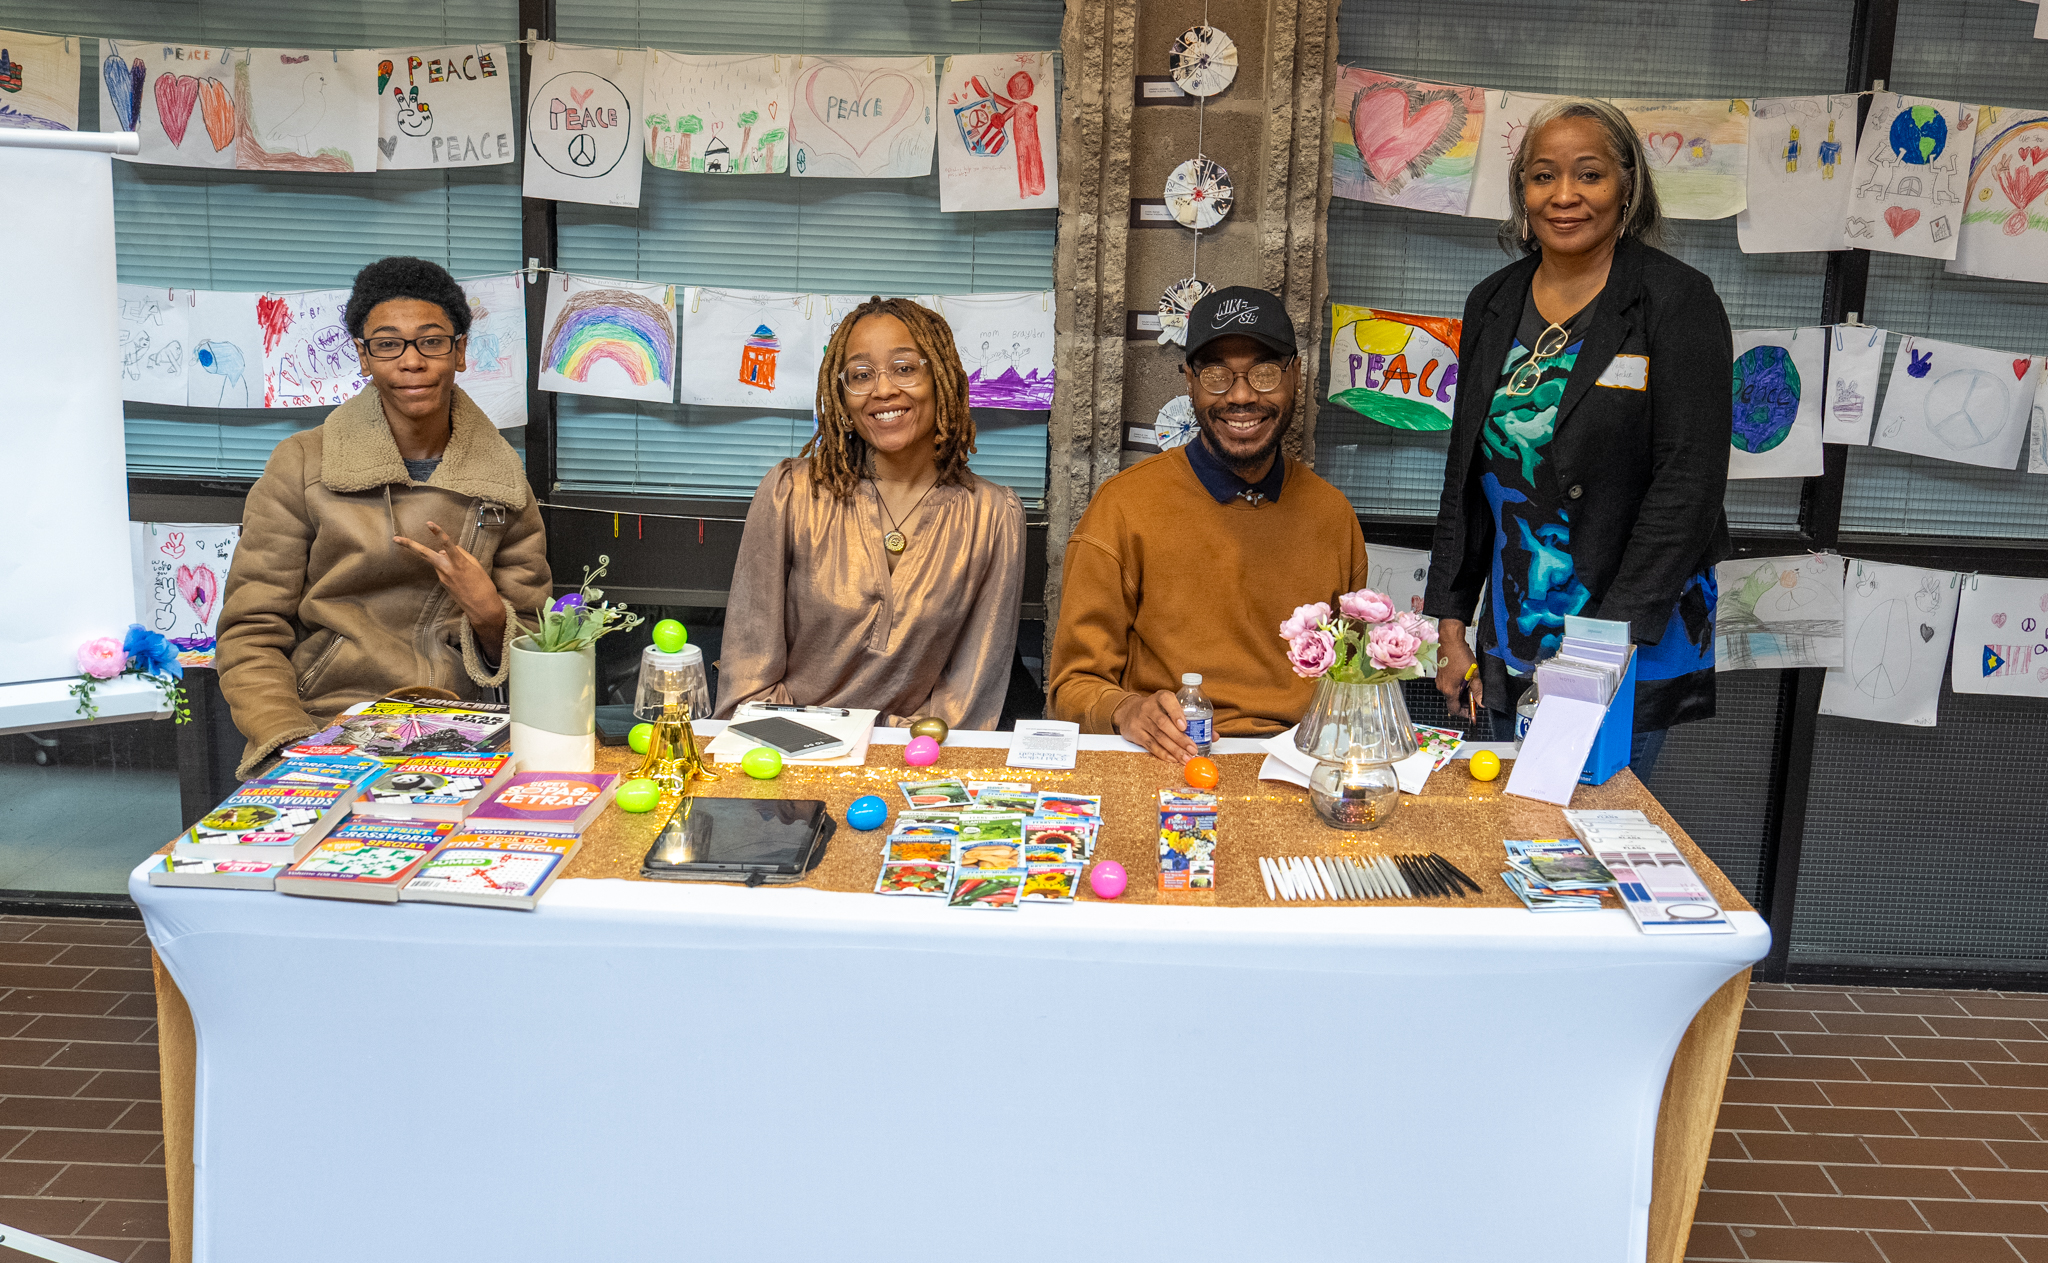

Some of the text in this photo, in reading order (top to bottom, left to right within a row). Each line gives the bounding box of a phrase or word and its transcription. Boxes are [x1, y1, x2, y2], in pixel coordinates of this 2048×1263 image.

[163, 47, 210, 61] PEACE
[407, 53, 498, 86] PEACE
[550, 98, 618, 130] PEACE
[827, 96, 883, 123] PEACE
[431, 132, 511, 163] PEACE
[1214, 299, 1249, 317] NIKE
[1239, 313, 1259, 324] SB
[1349, 353, 1460, 403] PEACE
[416, 698, 511, 711] MINECRAF
[287, 761, 368, 771] WORD-FINDS
[397, 765, 496, 775] CROSSWORDS
[240, 788, 288, 796] LARGE
[505, 785, 589, 796] SOPAS
[228, 795, 336, 806] CROSSWORDS
[493, 794, 594, 806] LETRAS
[336, 831, 442, 843] CROSSWORDS
[366, 840, 426, 849] SPECIAL
[506, 843, 566, 853] CIRCLE
[427, 858, 486, 866] JUMBO
